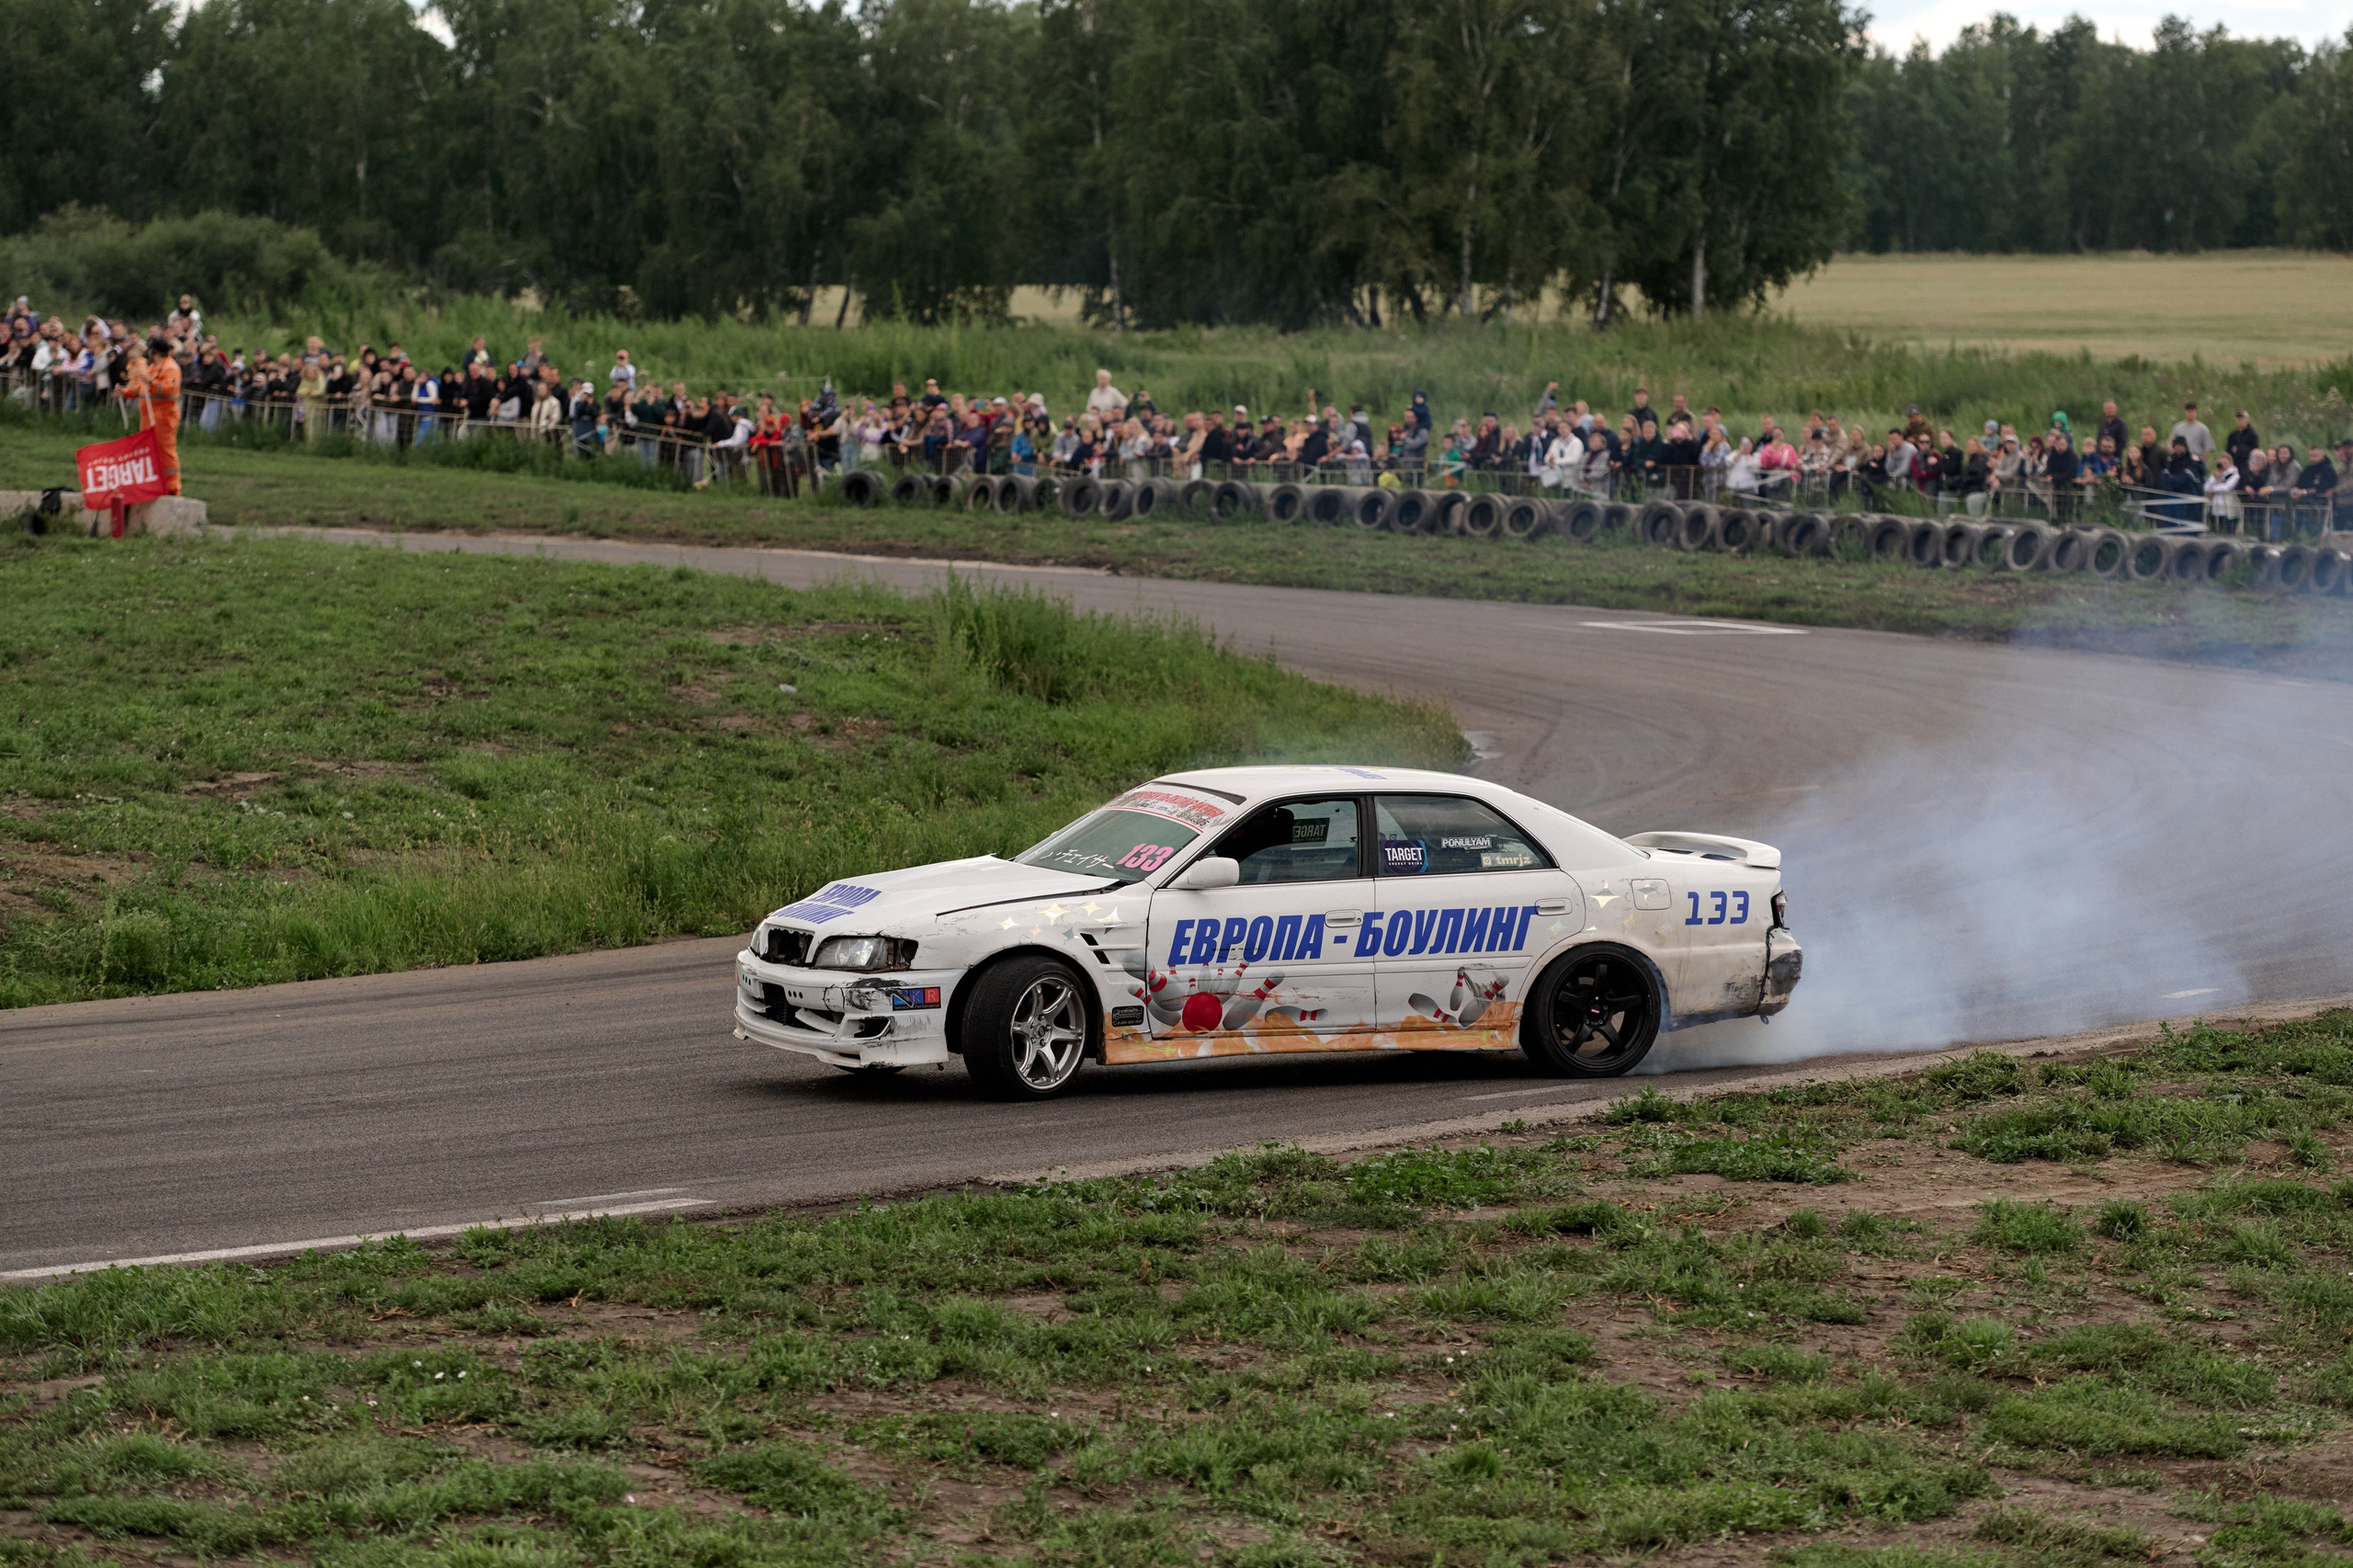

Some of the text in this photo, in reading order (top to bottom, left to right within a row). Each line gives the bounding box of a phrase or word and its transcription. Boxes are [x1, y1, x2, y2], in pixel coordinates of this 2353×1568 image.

[85, 455, 159, 494] TARGET
[1115, 842, 1175, 872] 133
[1384, 846, 1424, 861] TARGET
[1442, 837, 1491, 847] PONULYAM
[807, 883, 882, 909] ЕВРОПА
[1685, 891, 1750, 926] 133
[1167, 914, 1326, 966] ЕВРОПА
[1354, 905, 1541, 958] БОУЛИНГ
